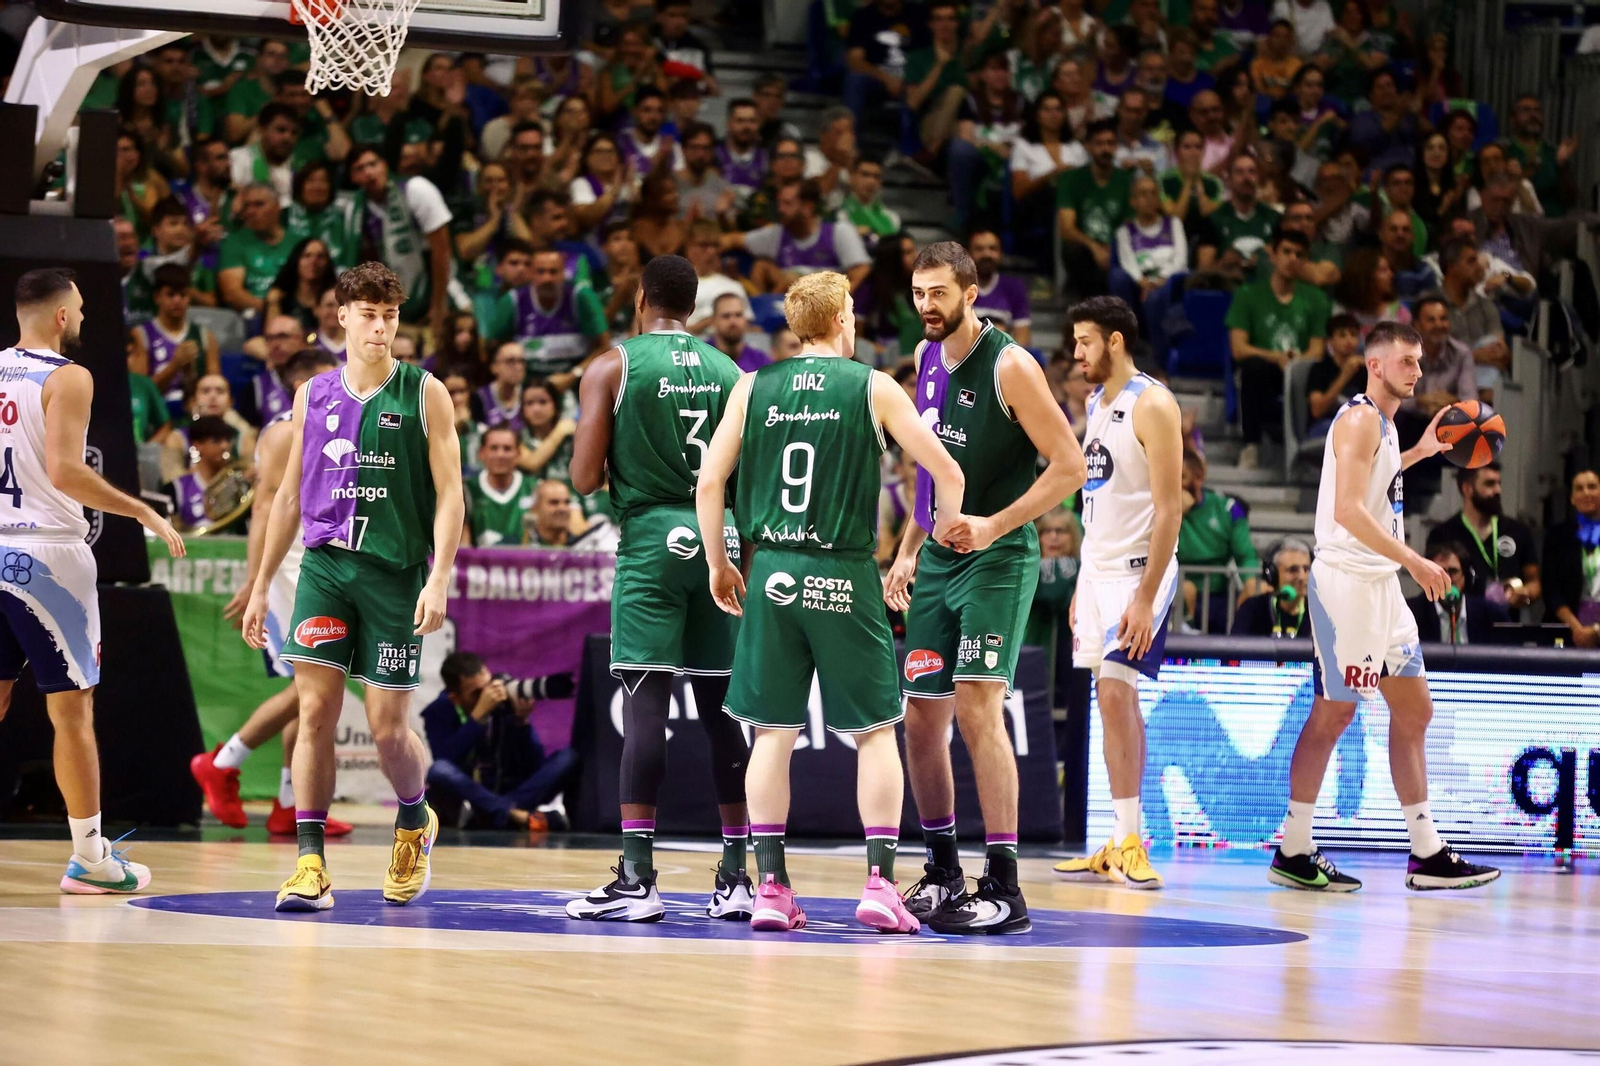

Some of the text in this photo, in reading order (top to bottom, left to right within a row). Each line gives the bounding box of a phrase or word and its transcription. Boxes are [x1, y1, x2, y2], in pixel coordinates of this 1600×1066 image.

[671, 350, 701, 367] EJIM
[792, 371, 825, 391] DÍAZ
[679, 409, 708, 476] 3
[354, 451, 396, 466] Unicaja
[781, 442, 815, 513] 9
[347, 515, 369, 551] 17
[803, 575, 853, 592] COSTA
[803, 588, 853, 603] DEL SOL
[802, 599, 852, 614] MÁLAGA
[1344, 665, 1380, 688] Río
[1510, 748, 1600, 849] q
